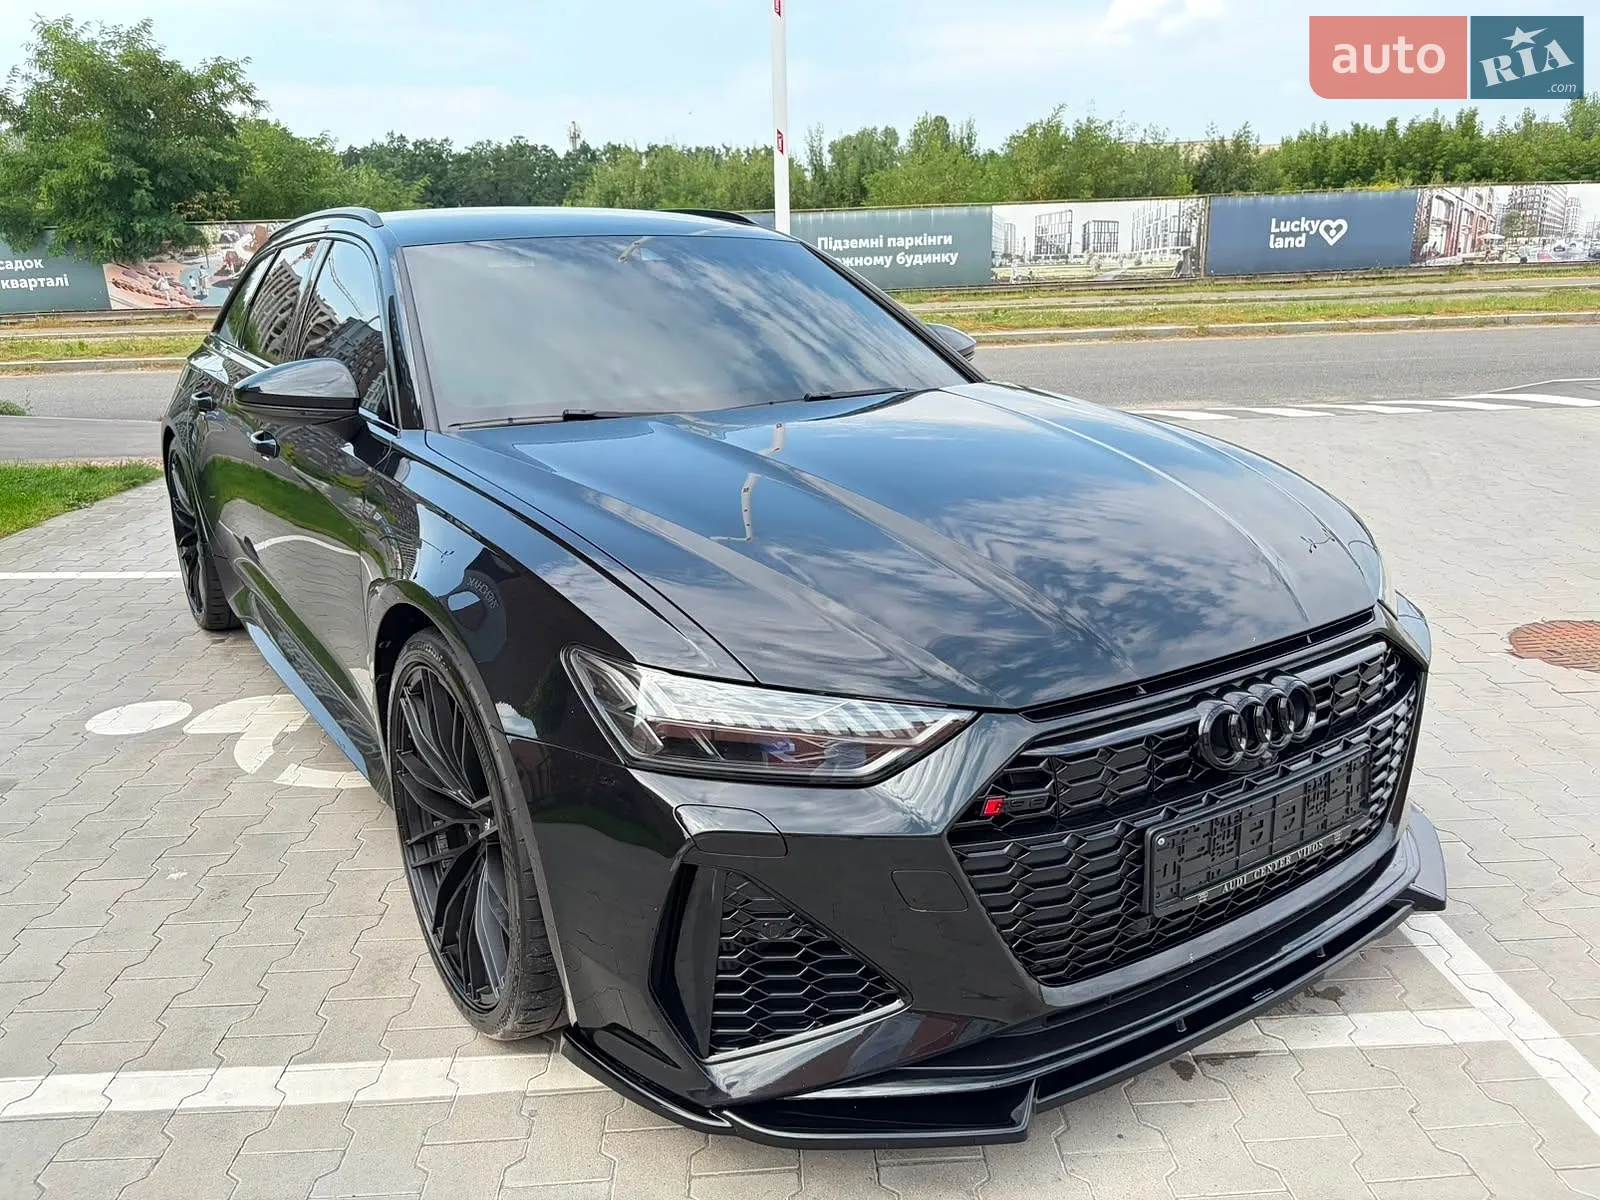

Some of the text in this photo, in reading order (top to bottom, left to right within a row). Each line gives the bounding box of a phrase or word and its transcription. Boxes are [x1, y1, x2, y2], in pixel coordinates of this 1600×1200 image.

[1270, 216, 1320, 235] Lucky
[817, 233, 953, 251] Підземні паркінги
[1269, 233, 1306, 248] land
[896, 251, 959, 268] будинку
[1, 273, 69, 291] кварталі
[1222, 874, 1248, 894] AUDI
[1253, 855, 1292, 879] CENTER
